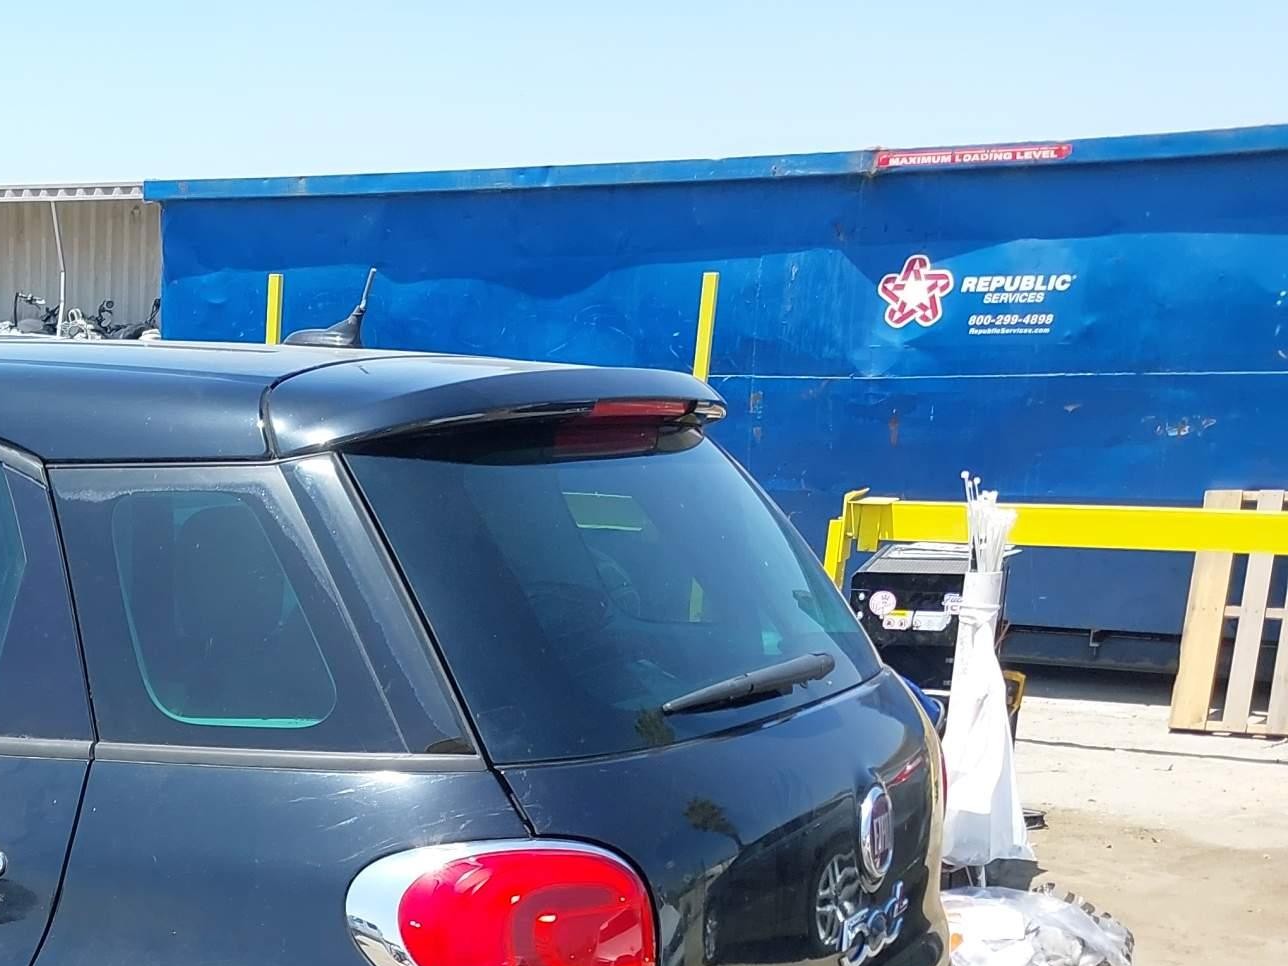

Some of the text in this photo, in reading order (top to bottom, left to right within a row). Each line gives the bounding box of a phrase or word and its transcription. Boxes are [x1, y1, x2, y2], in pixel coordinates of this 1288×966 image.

[888, 148, 1059, 166] MAXIMUM LOADING LEVEL
[960, 273, 1073, 293] REPUBLIC
[982, 292, 1046, 304] SERVICES
[967, 313, 1055, 326] 800-299-4898
